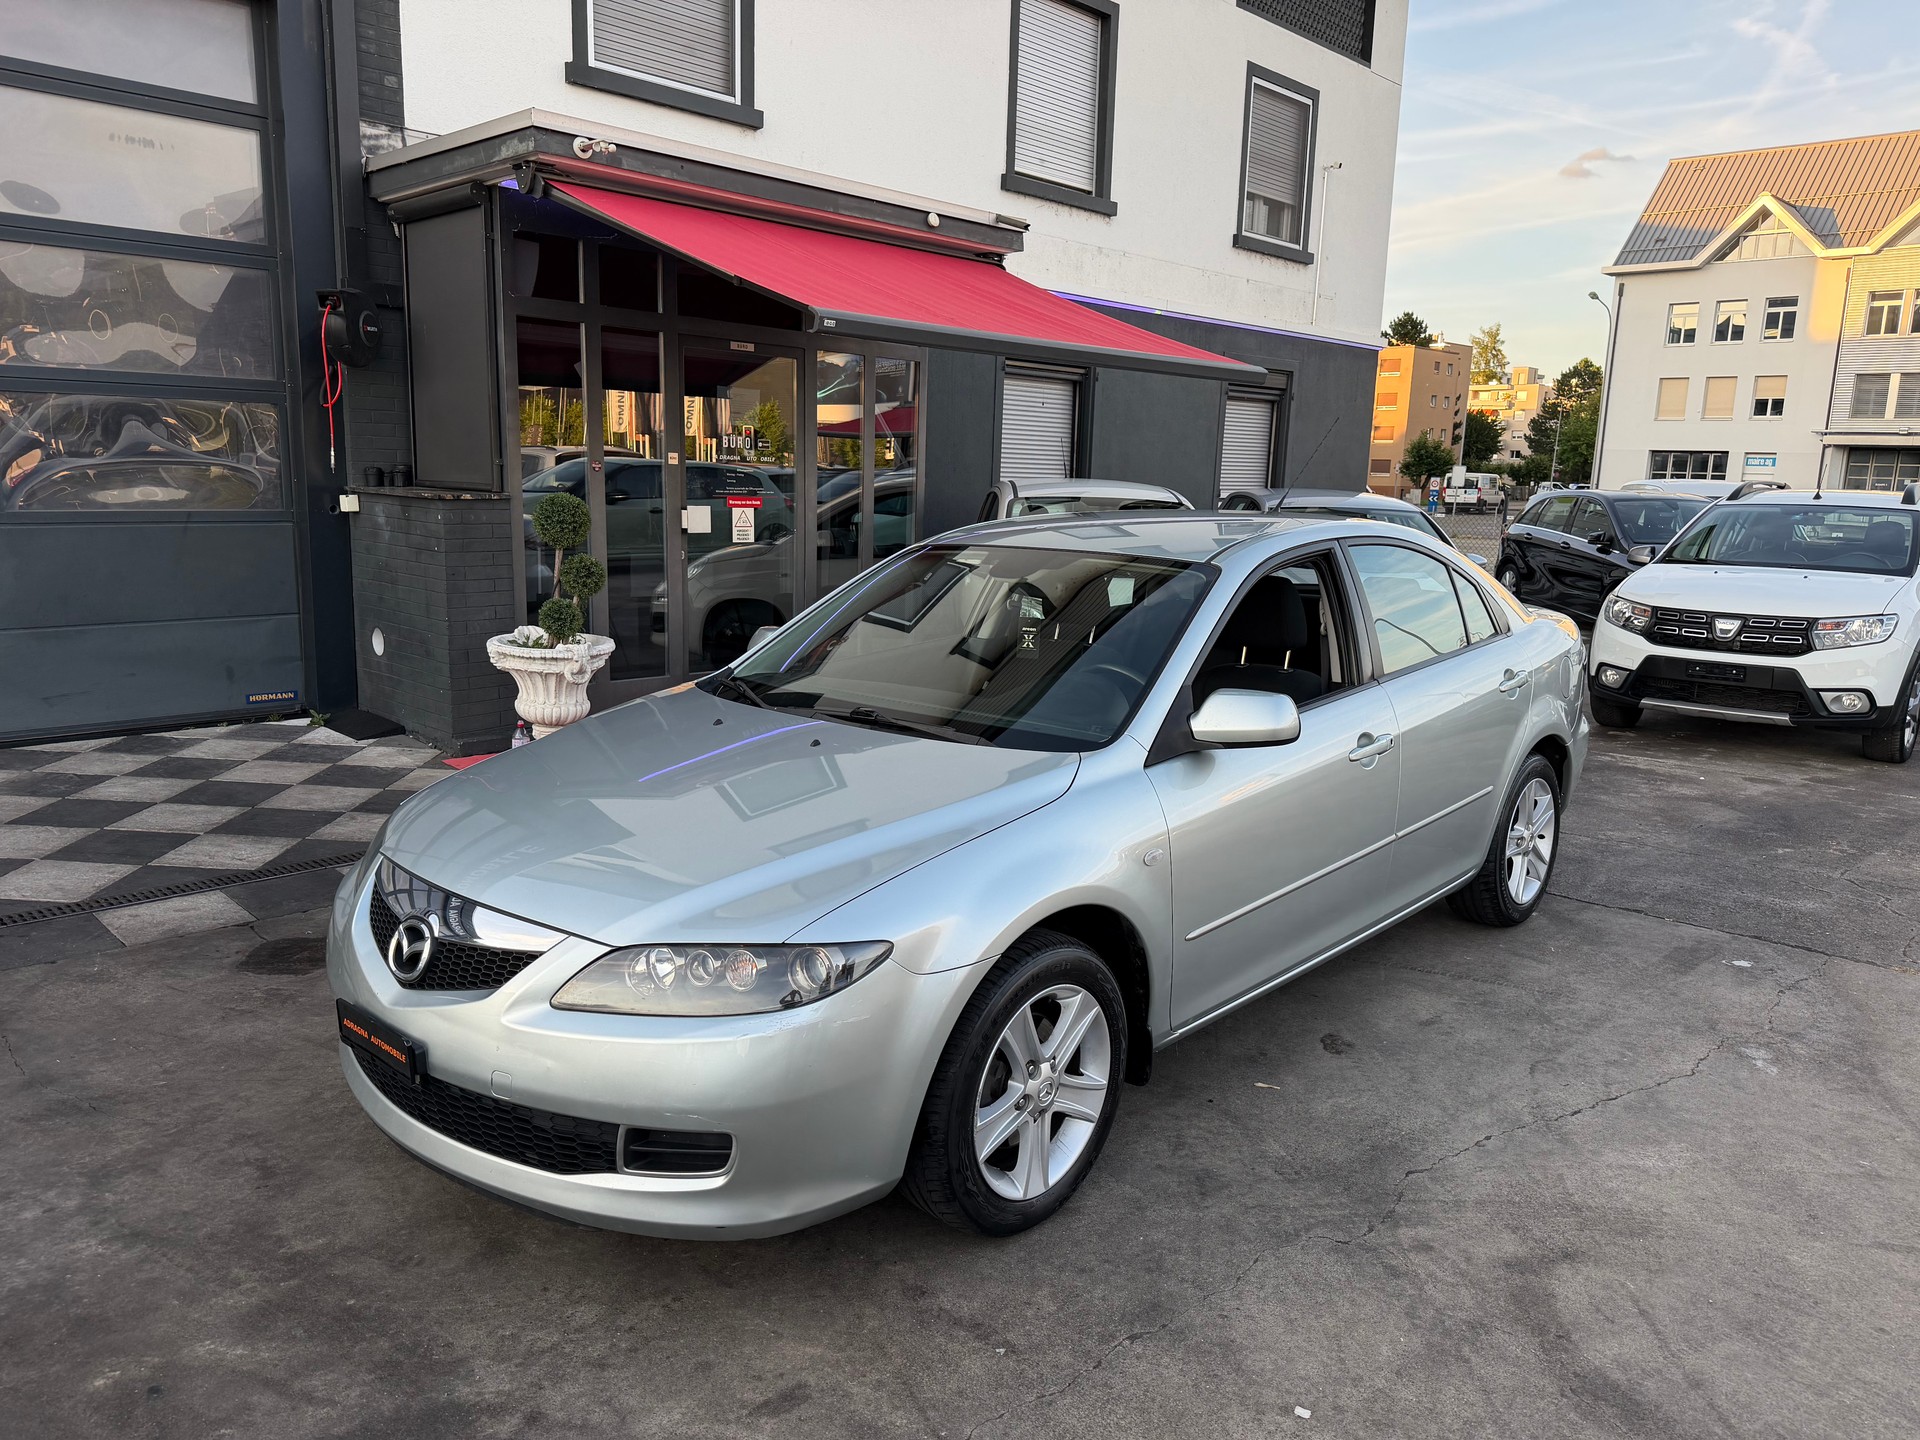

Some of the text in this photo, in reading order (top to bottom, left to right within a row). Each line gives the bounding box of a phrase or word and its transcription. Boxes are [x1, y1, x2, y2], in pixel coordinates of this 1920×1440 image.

[722, 434, 751, 449] BÜRO
[343, 1018, 407, 1063] ADRAGNA AUTOMOBILE
